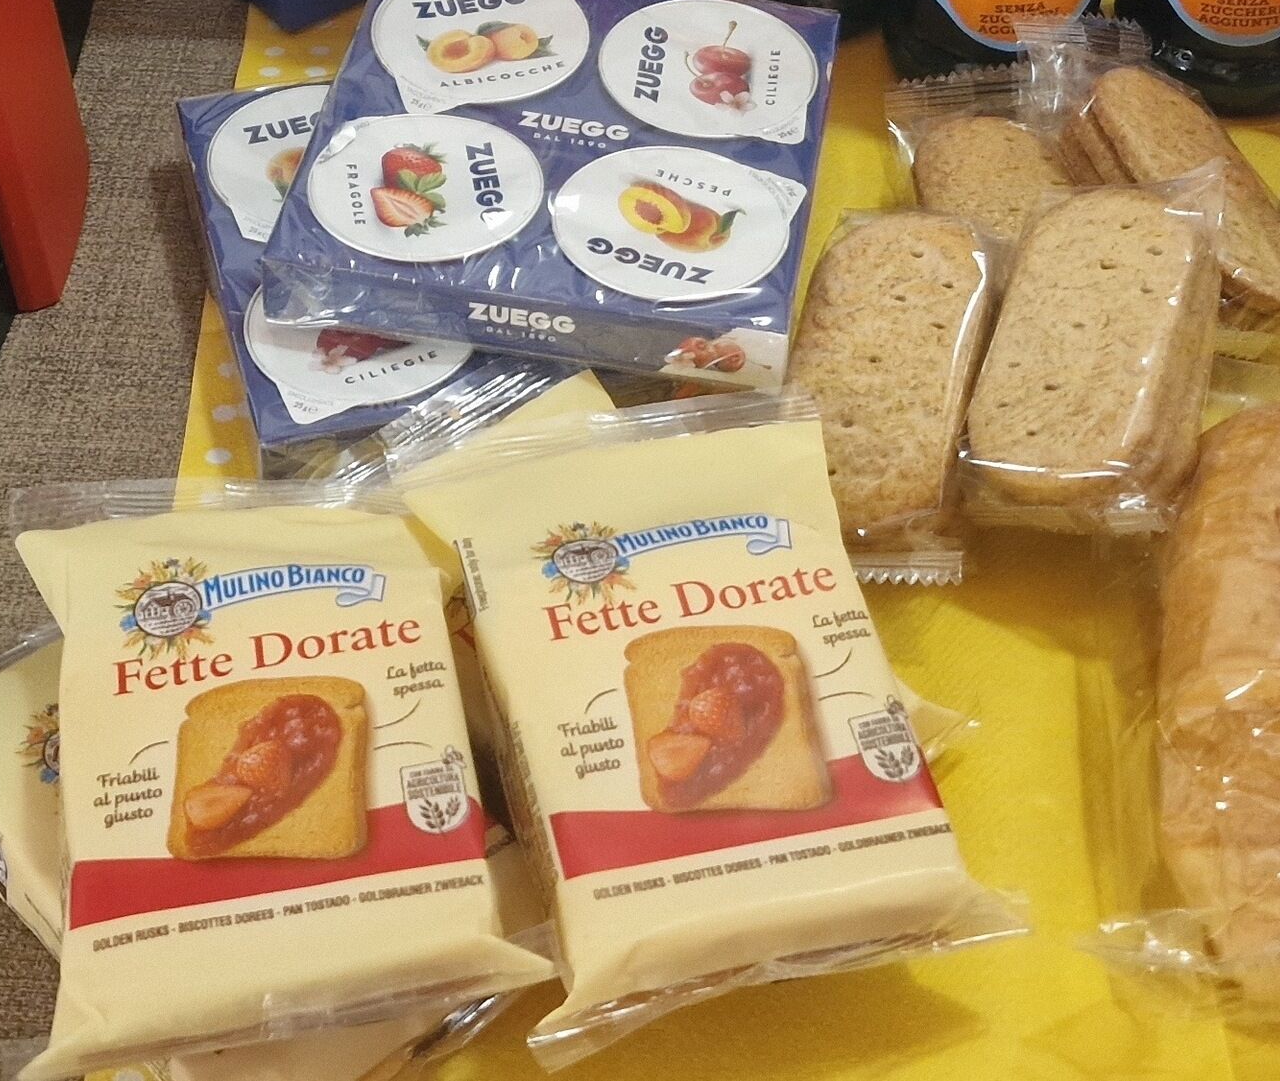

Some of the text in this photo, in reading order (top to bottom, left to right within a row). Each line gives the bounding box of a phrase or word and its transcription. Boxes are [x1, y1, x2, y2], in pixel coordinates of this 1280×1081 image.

[994, 1, 1045, 14] SENZA
[440, 61, 565, 88] ALBICOCCHE
[634, 26, 669, 103] ZUEGG
[765, 50, 781, 106] CILIEGIE
[519, 111, 630, 141] ZUEGG
[533, 133, 606, 149] DAL 1890
[346, 164, 366, 225] FRAGOLE
[656, 169, 732, 197] PESCHE
[586, 237, 714, 285] ZUEGG
[469, 302, 576, 334] ZUEGG
[486, 327, 557, 343] DAL 1890
[345, 349, 438, 385] CILIEGIE
[616, 514, 768, 555] MULINO BIANCO
[202, 565, 366, 608] MULINO BIANCO
[542, 566, 837, 641] Fette Dorate
[812, 608, 868, 629] La fetta
[822, 627, 870, 648] spessa
[112, 653, 233, 696] Fette
[249, 619, 422, 670] Dorate
[386, 660, 447, 682] La fetta
[393, 676, 444, 699] spessa
[557, 717, 618, 739] Friabili
[560, 736, 624, 760] al punto
[96, 768, 160, 790] Friabili
[575, 758, 620, 779] giusto
[93, 786, 163, 811] al punto
[104, 808, 154, 829] giusto
[93, 930, 133, 952] GOLDEN
[135, 924, 169, 942] RUSKS
[178, 915, 232, 933] BISCOTTES
[283, 903, 302, 916] PAN
[305, 895, 350, 912] TOSTADO
[359, 882, 432, 903] GOLDBRAUNER
[434, 875, 483, 892] ZWIEBACK
